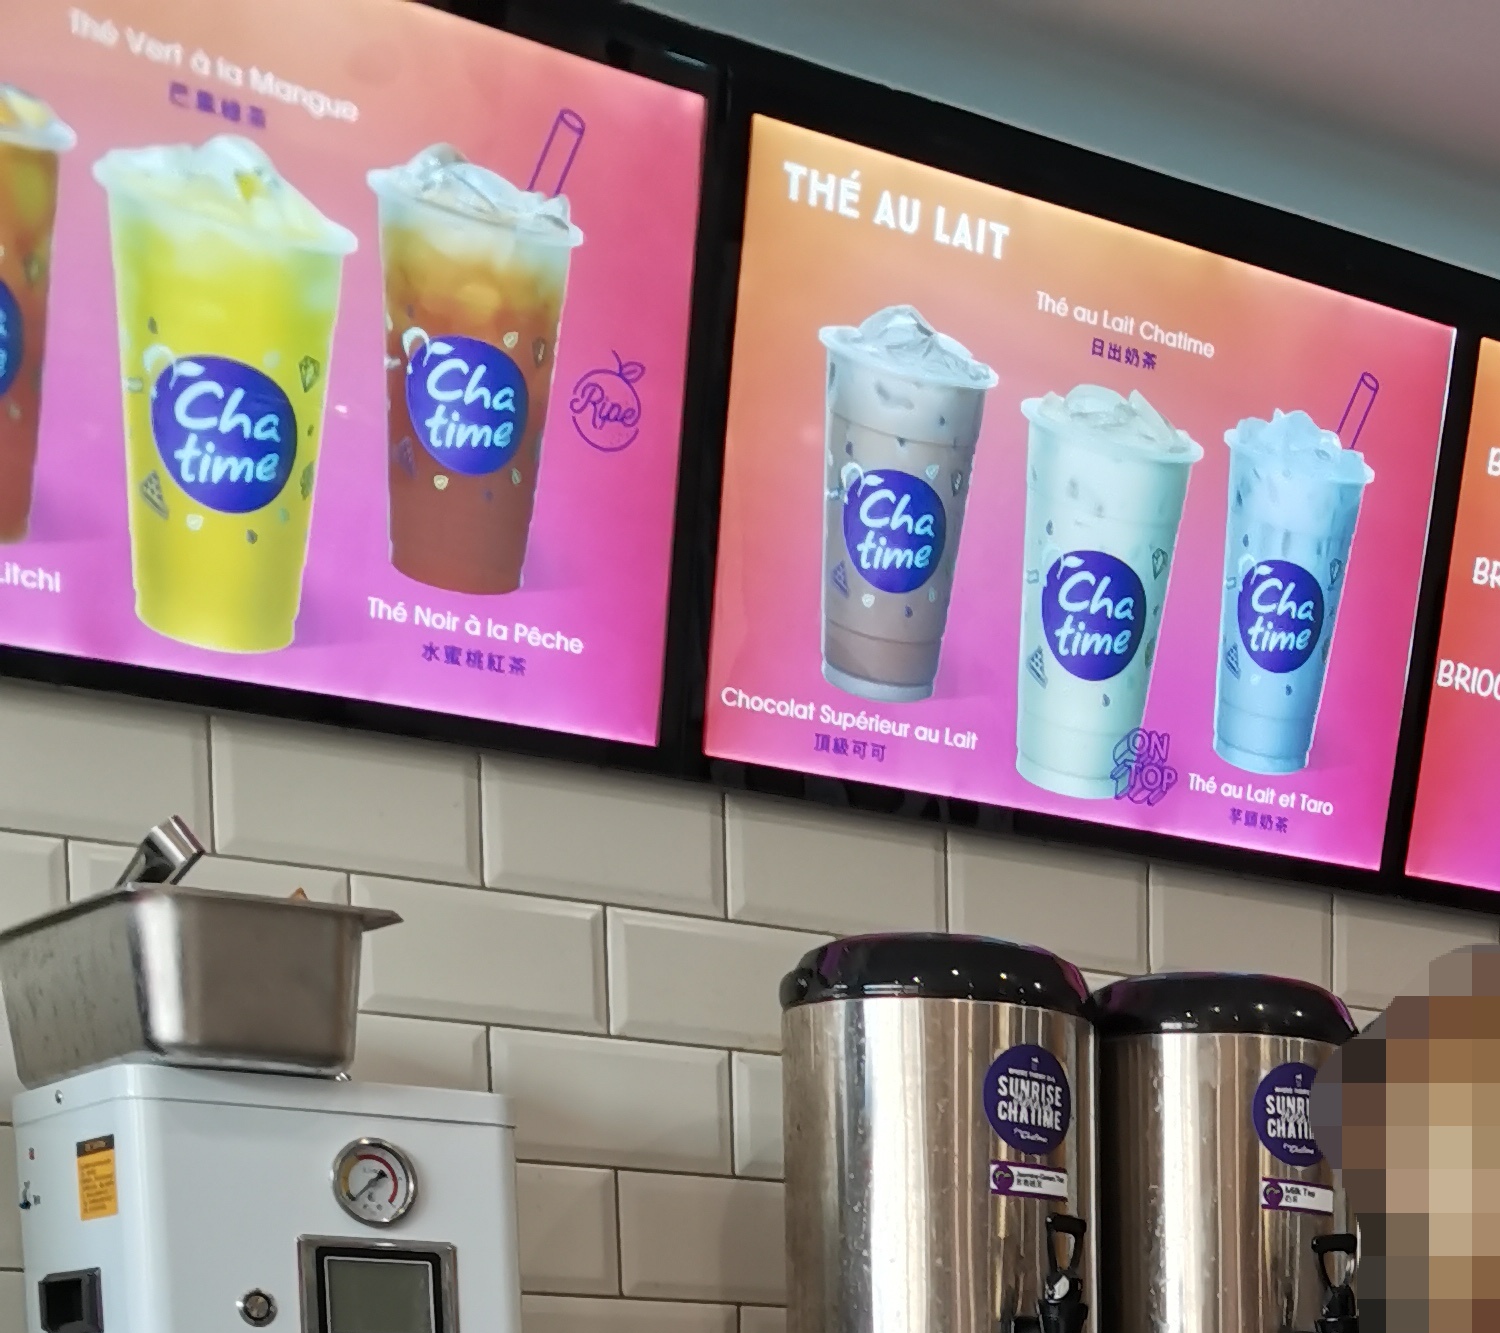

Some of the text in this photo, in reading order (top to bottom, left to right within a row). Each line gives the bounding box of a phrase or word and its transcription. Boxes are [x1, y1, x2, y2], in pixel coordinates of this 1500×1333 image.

[125, 27, 183, 66] Vert
[190, 47, 211, 77] à
[216, 56, 243, 87] la
[248, 66, 359, 121] Mangue
[783, 161, 1010, 261] THÉ AU LAIT
[1036, 289, 1216, 358] Thé au Lait Chatime
[1091, 336, 1158, 370] 日出奶茶
[426, 358, 517, 414] Cha
[569, 381, 637, 431] Ripe
[175, 379, 282, 444] Cha
[425, 405, 514, 450] time
[174, 438, 280, 484] time
[857, 489, 936, 538] Cha
[856, 534, 932, 571] time
[0, 561, 61, 594] itchi
[1058, 571, 1135, 622] Cha
[1251, 576, 1316, 622] Cha
[367, 596, 585, 654] Thé Noir à la Pêche
[1055, 618, 1131, 656] time
[1248, 617, 1311, 652] time
[720, 686, 979, 751] Chocolat Supérieur au Lait
[1121, 727, 1171, 766] ON
[1187, 772, 1334, 816] Thé au Lait et Taro
[997, 1075, 1063, 1108] SUNRISE
[1265, 1094, 1310, 1117] SUNRI
[997, 1100, 1062, 1132] CHATIME
[1266, 1118, 1315, 1140] CHATI
